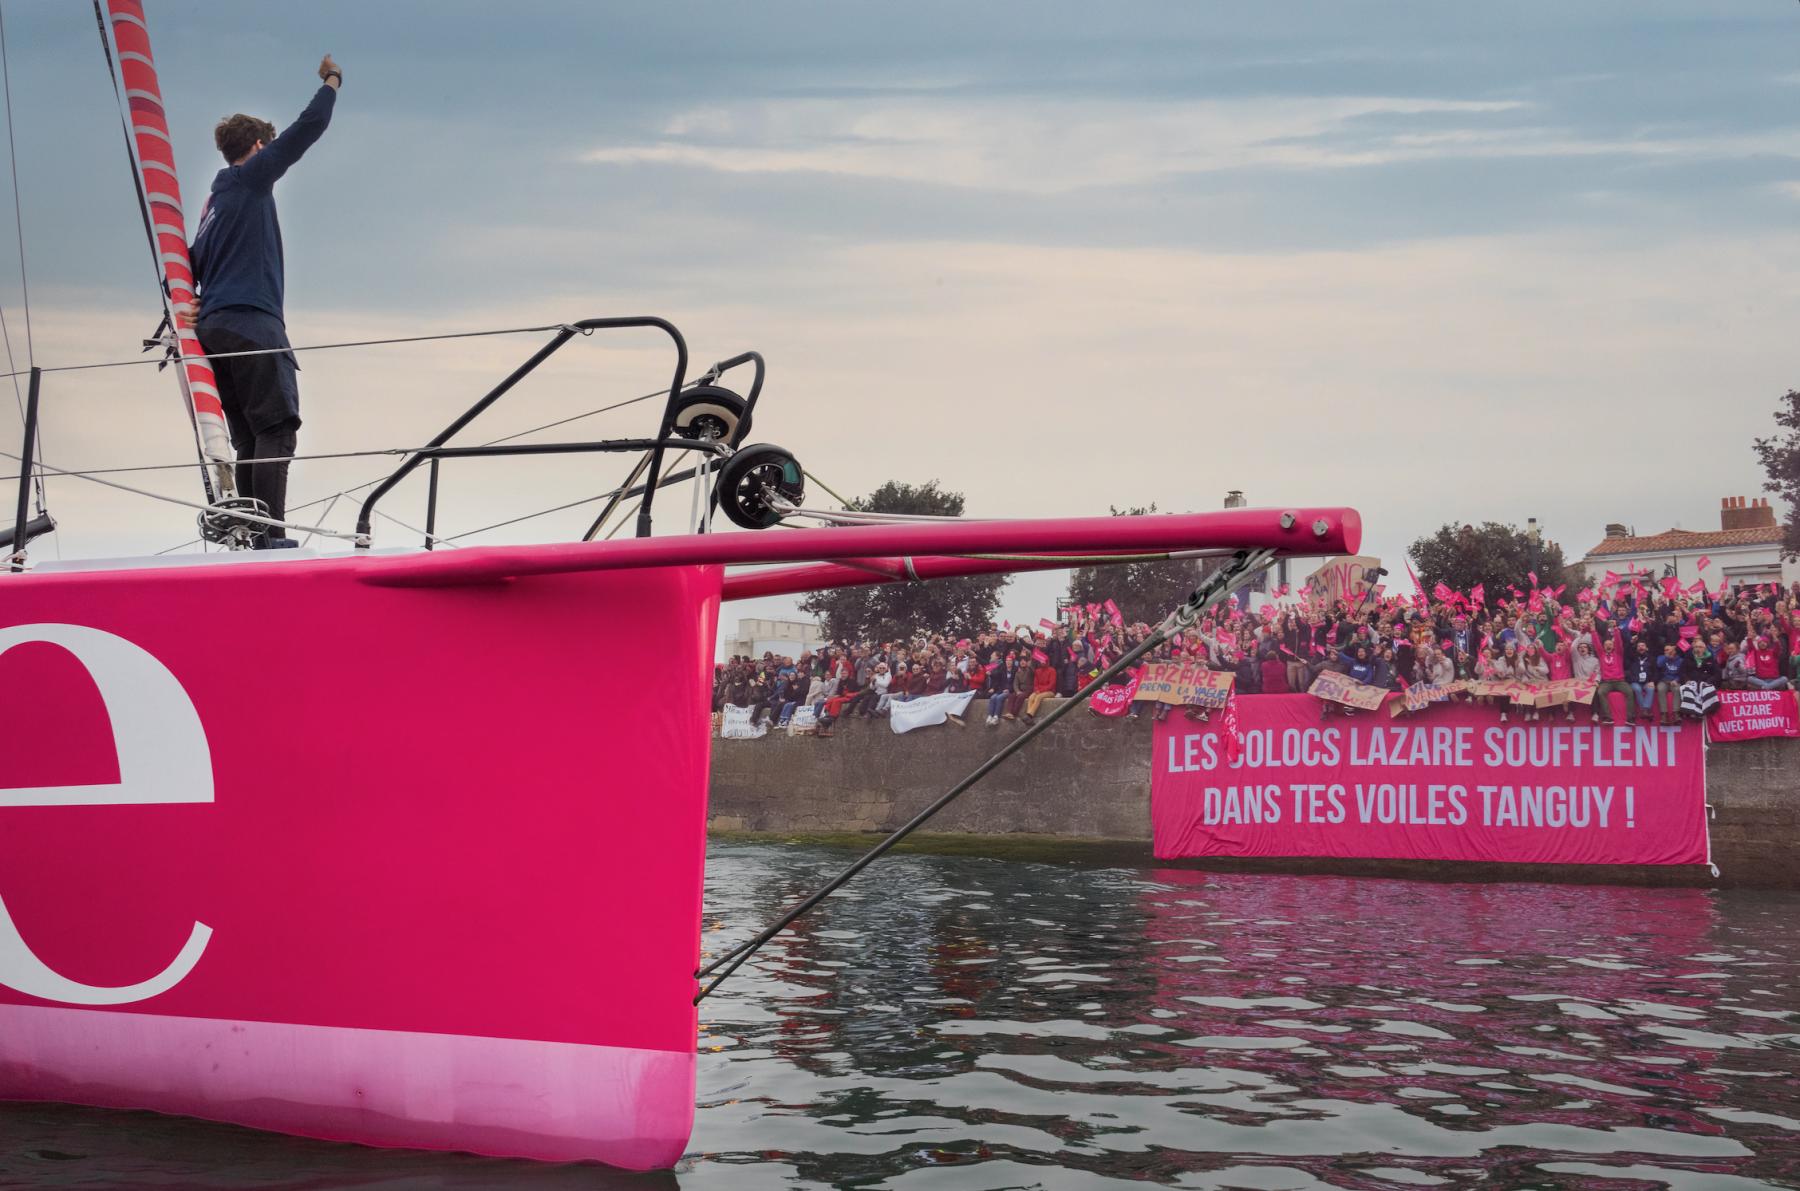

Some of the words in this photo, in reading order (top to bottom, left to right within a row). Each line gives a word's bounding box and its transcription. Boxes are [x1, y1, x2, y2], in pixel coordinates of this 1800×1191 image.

[1142, 664, 1221, 688] LAZARE
[1721, 692, 1740, 703] LES
[1741, 691, 1781, 702] COLOCS
[1732, 704, 1772, 717] LAZARE
[1718, 720, 1744, 733] AVEC
[1168, 733, 1218, 773] LES
[1350, 727, 1474, 766] LAZARE
[1484, 726, 1681, 767] SOUFFLENT
[1203, 785, 1281, 825] DANS
[1289, 784, 1345, 824] TES
[1355, 784, 1468, 825] VOILES
[1477, 785, 1614, 827] TANGUY
